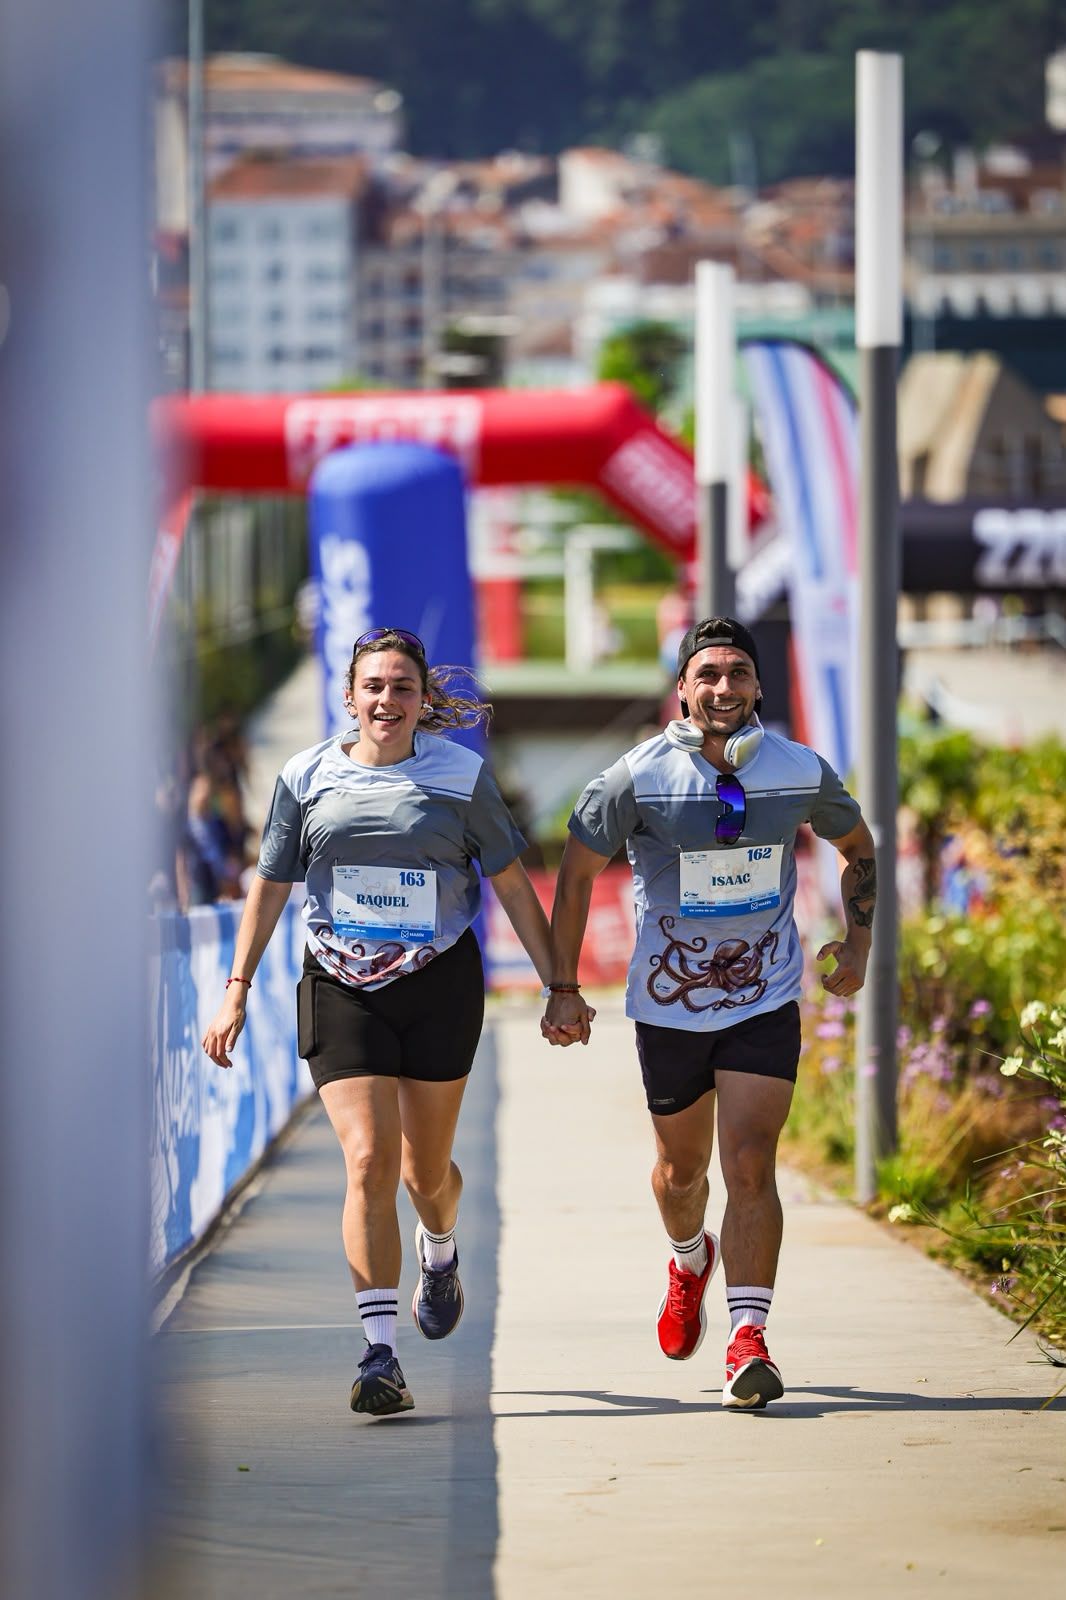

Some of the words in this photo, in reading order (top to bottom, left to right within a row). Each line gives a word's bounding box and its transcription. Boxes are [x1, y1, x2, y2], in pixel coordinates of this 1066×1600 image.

[747, 847, 772, 862] 162
[399, 871, 426, 887] 163
[712, 873, 751, 887] ISAAC
[356, 893, 409, 908] RAQUEL
